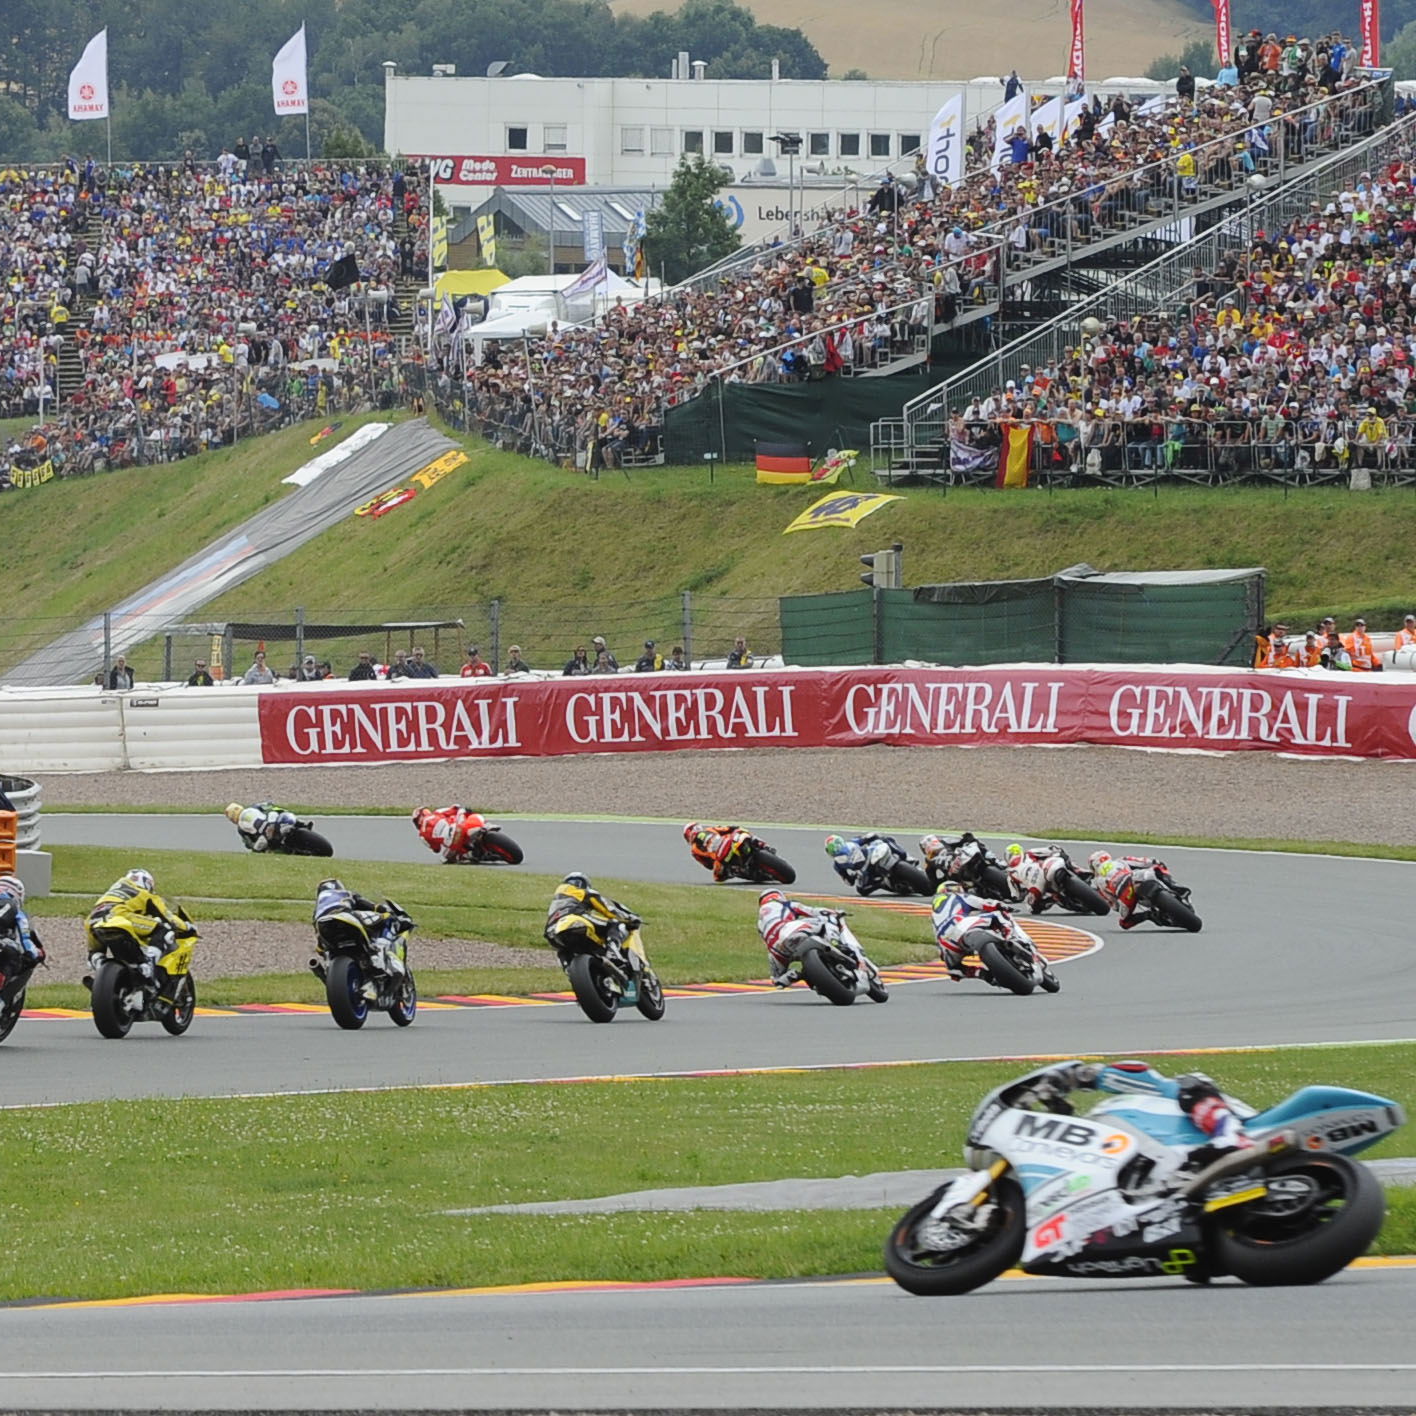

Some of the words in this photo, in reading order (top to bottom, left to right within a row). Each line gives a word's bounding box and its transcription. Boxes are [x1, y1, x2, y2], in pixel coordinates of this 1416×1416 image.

[459, 171, 498, 182] Center
[462, 159, 496, 170] Mode
[286, 696, 522, 755] GENERALI
[564, 685, 799, 744] GENERALI
[844, 681, 1064, 735] GENERALI
[1109, 685, 1352, 748] GENERALI
[1014, 1114, 1099, 1146] MB
